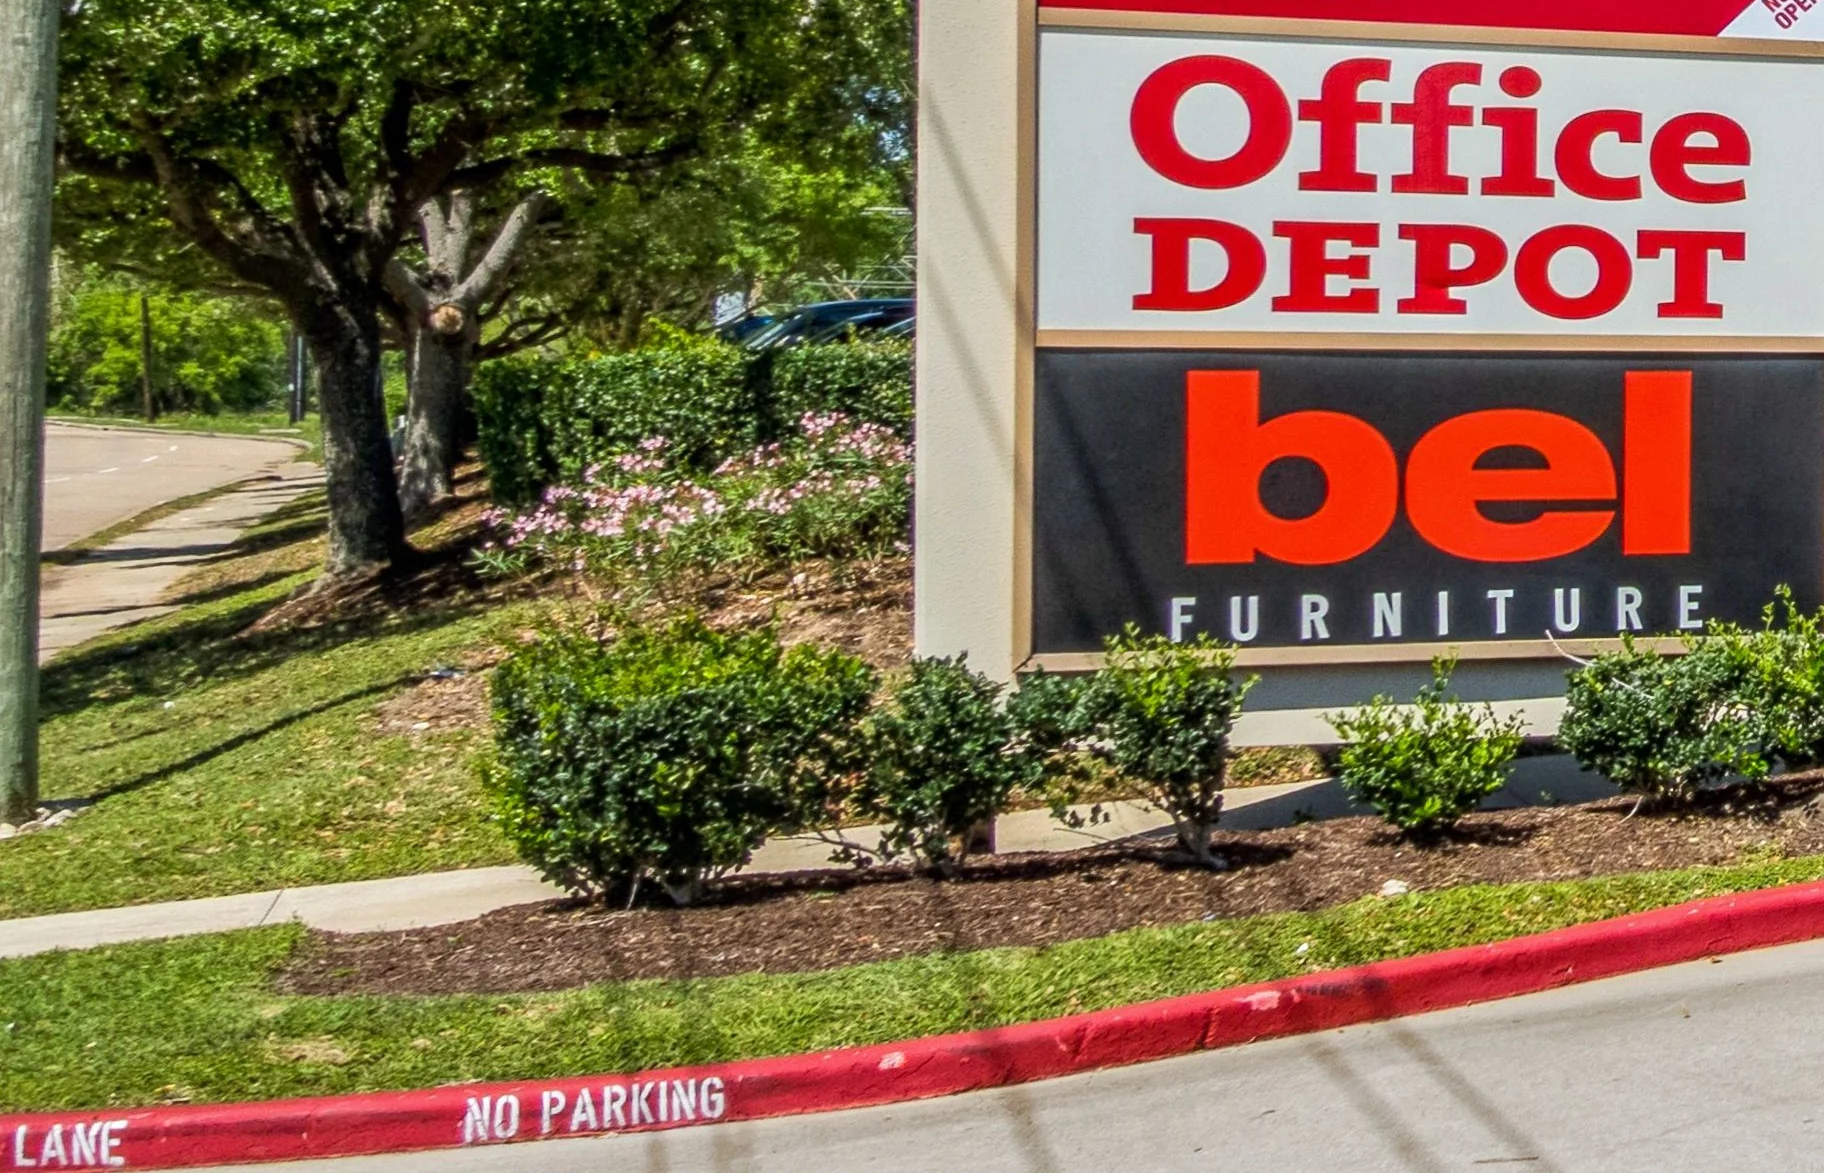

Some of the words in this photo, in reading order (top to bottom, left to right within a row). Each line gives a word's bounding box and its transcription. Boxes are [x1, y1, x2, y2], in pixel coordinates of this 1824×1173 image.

[1129, 54, 1752, 204] Office
[1132, 217, 1746, 320] DEPOT
[1185, 370, 1692, 566] bel
[1170, 585, 1704, 643] FURNITURE
[15, 1119, 128, 1167] LANE
[461, 1092, 521, 1145] NO
[541, 1075, 726, 1134] PARKING
